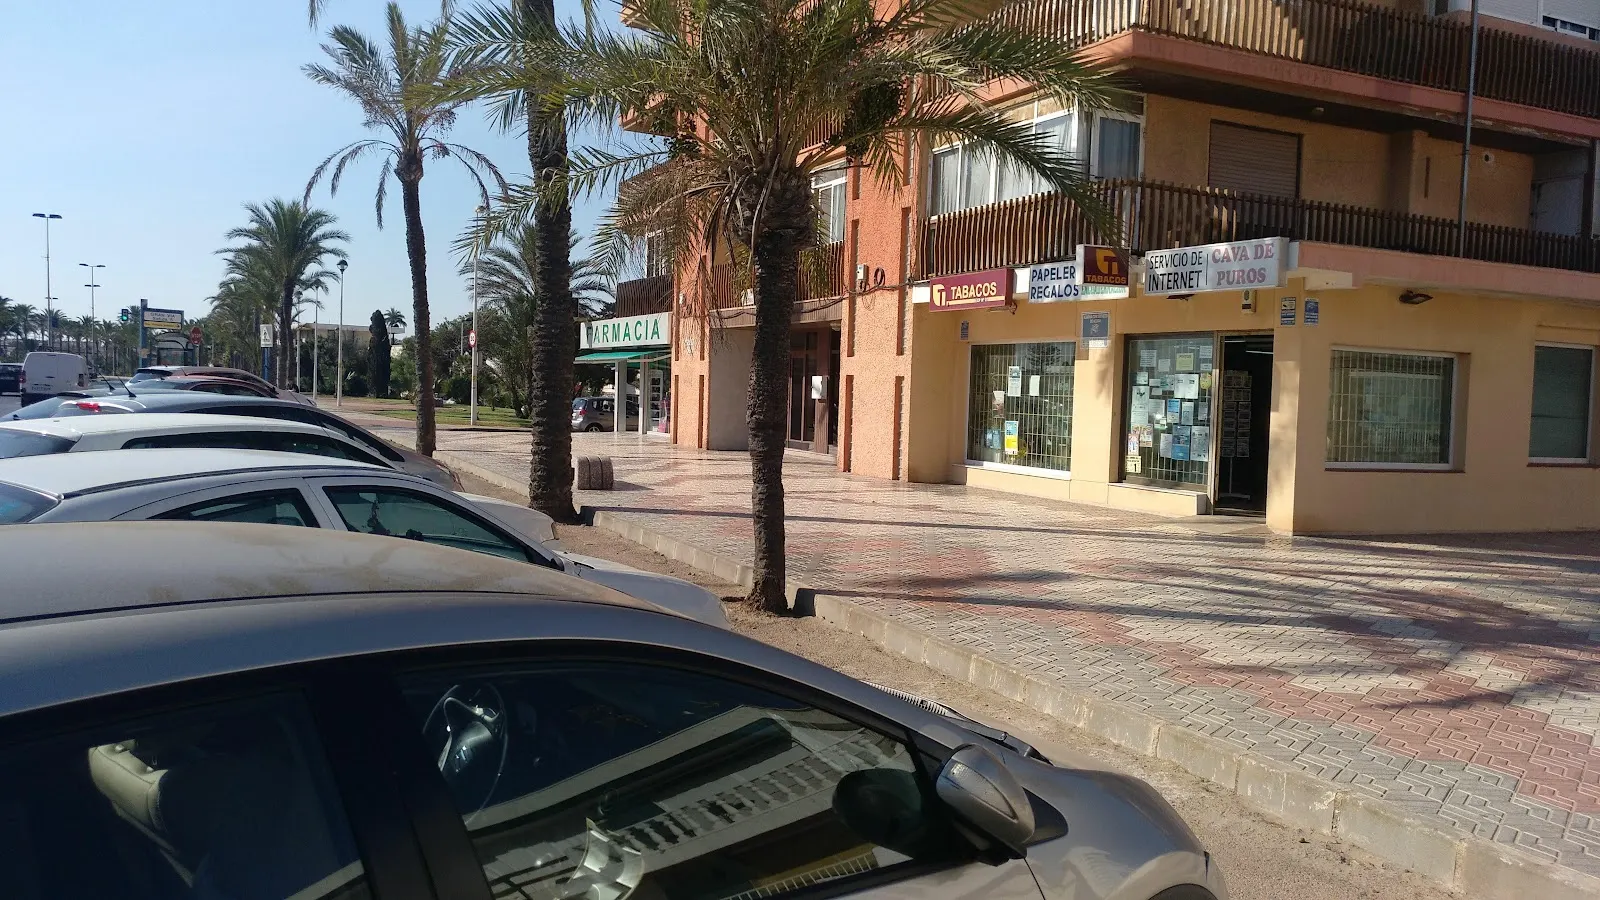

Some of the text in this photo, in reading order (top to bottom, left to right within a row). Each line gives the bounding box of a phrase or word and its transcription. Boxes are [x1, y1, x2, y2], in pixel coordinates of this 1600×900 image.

[1149, 250, 1203, 270] SERVICIO DE
[1211, 242, 1274, 264] CAVA DE
[1031, 265, 1076, 282] PAPELER
[1086, 274, 1127, 284] TABACOS
[1148, 270, 1202, 292] INTERNET
[1216, 267, 1267, 286] PUROS
[950, 281, 997, 300] TABACOS
[1030, 283, 1079, 300] REGALOS
[586, 319, 660, 343] FARMACIA
